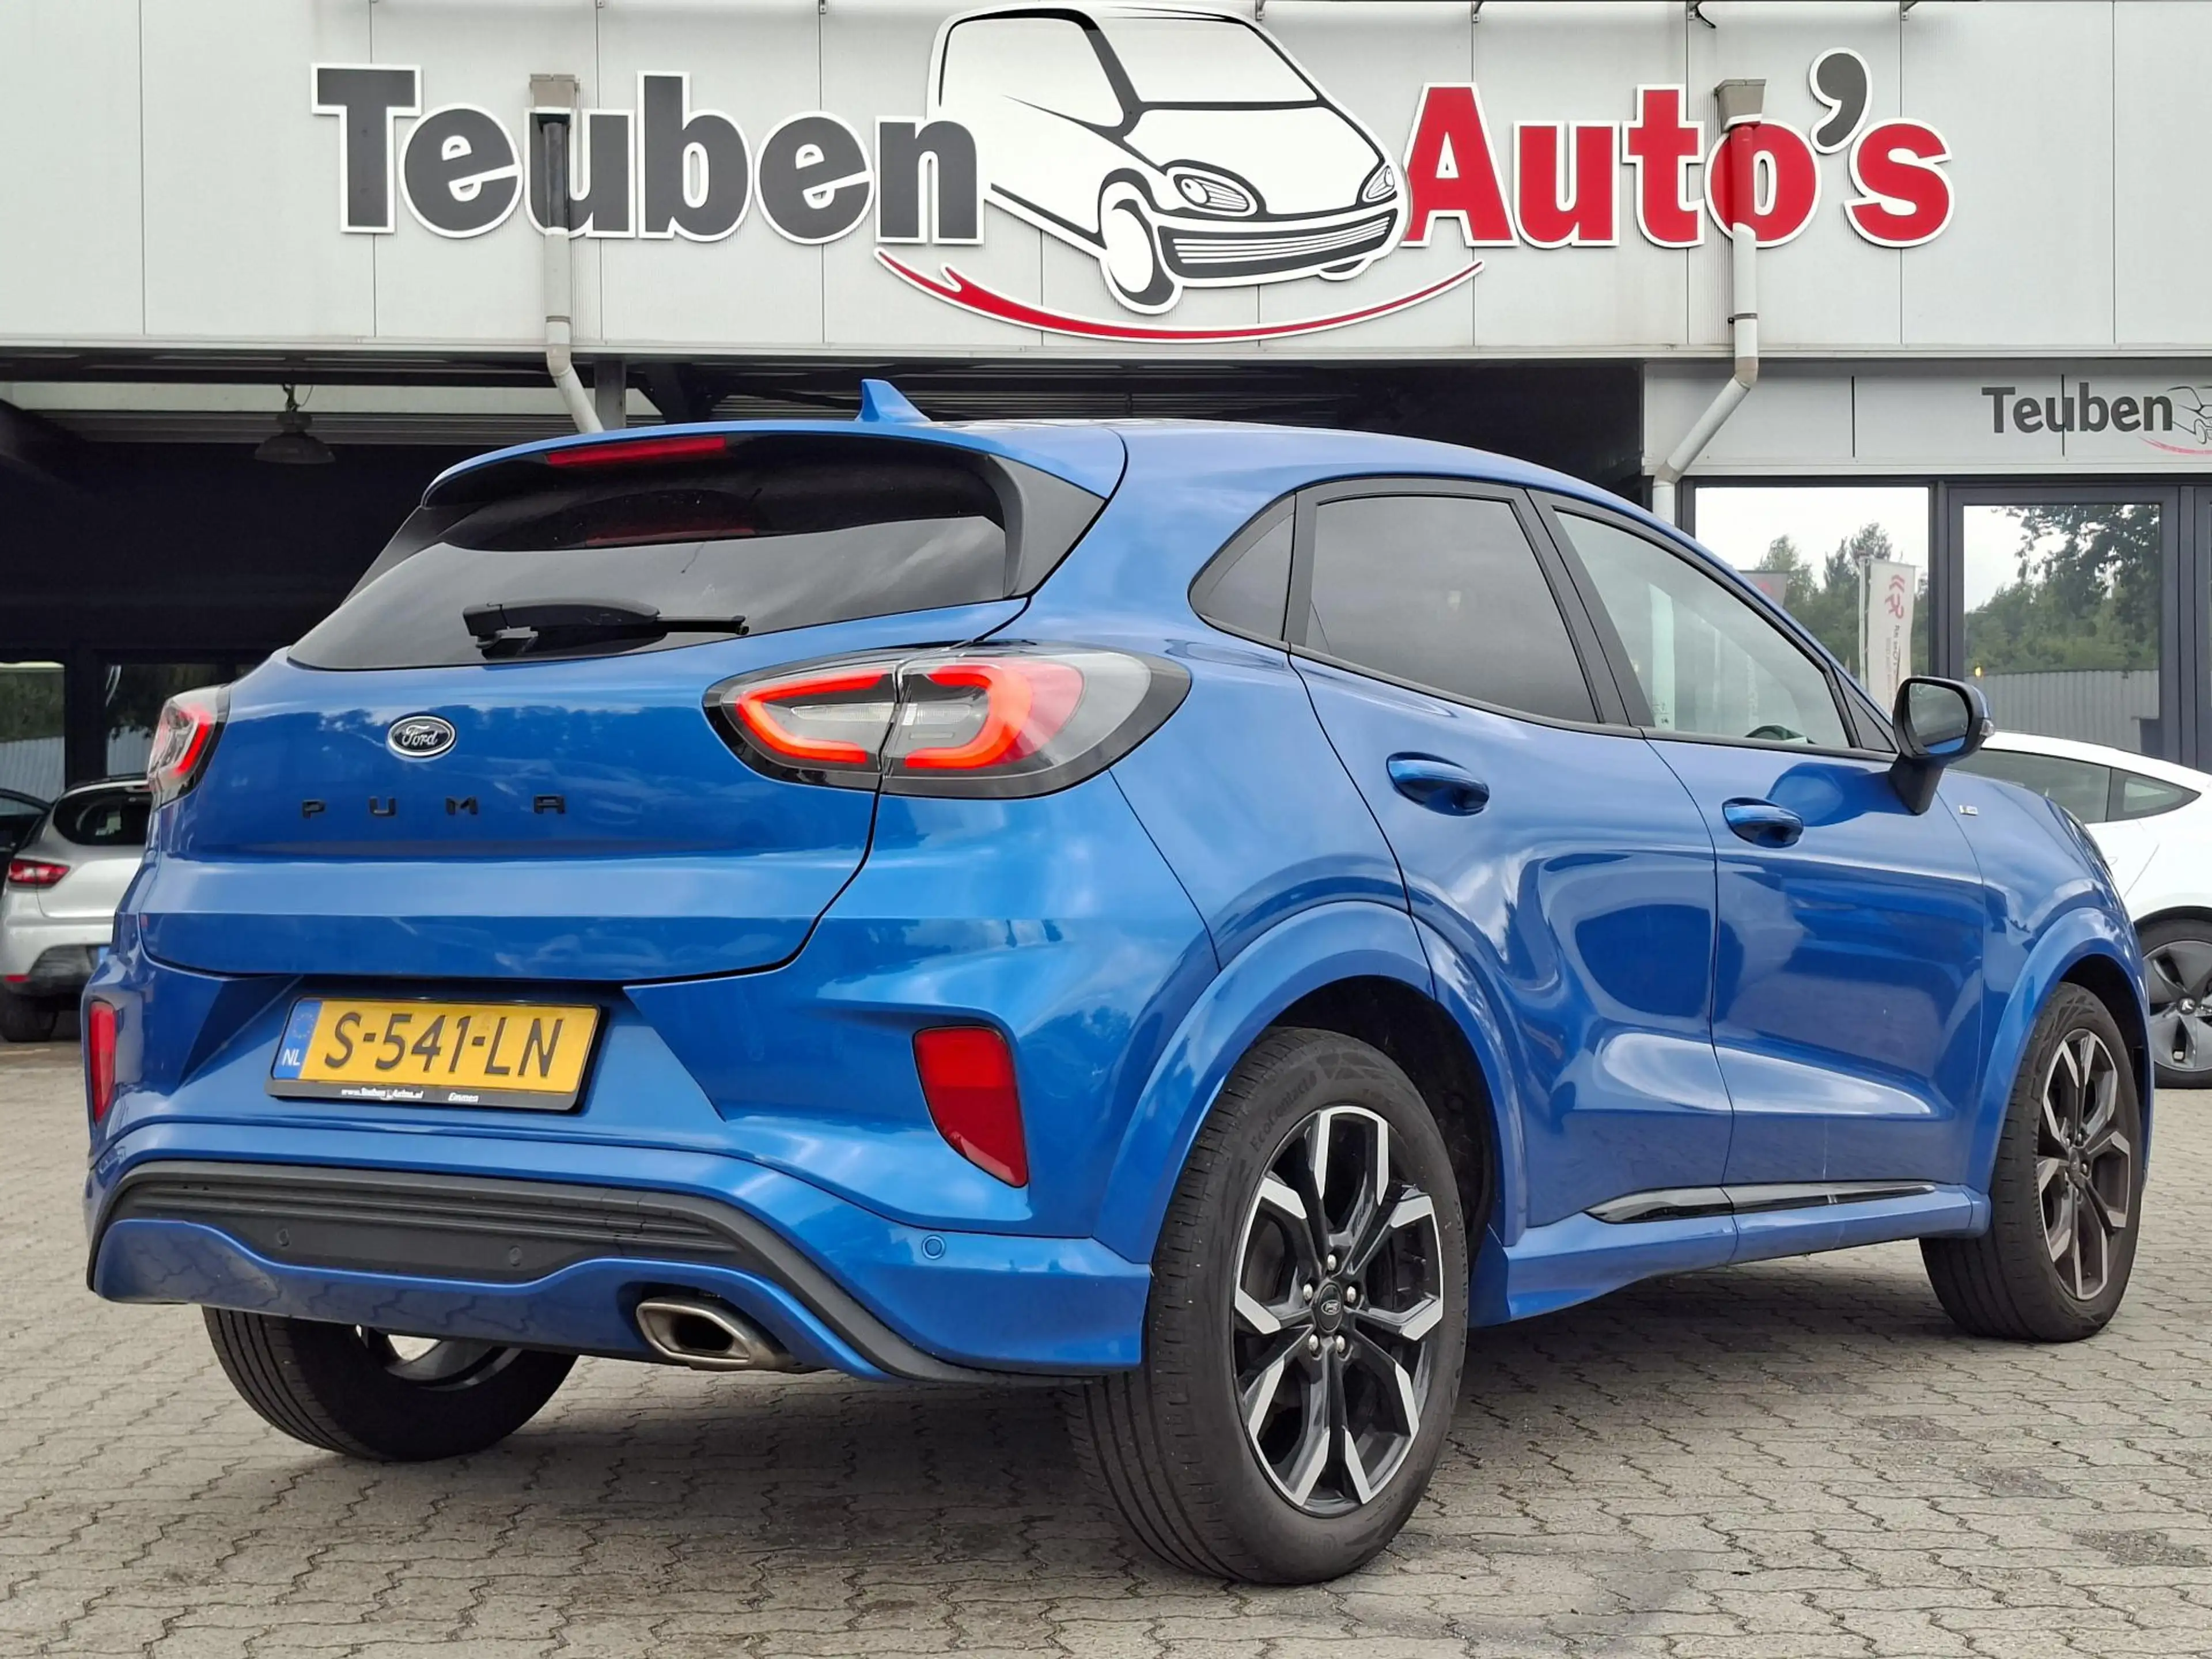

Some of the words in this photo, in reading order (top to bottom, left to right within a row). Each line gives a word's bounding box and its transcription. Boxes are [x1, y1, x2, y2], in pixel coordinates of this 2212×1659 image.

[313, 65, 983, 243] Teuben
[1406, 47, 1953, 247] Auto's
[1981, 382, 2173, 433] Teuben
[401, 724, 438, 747] Ford
[302, 794, 566, 819] PUMA
[281, 1048, 301, 1067] NL
[324, 1012, 565, 1078] S-541-LN
